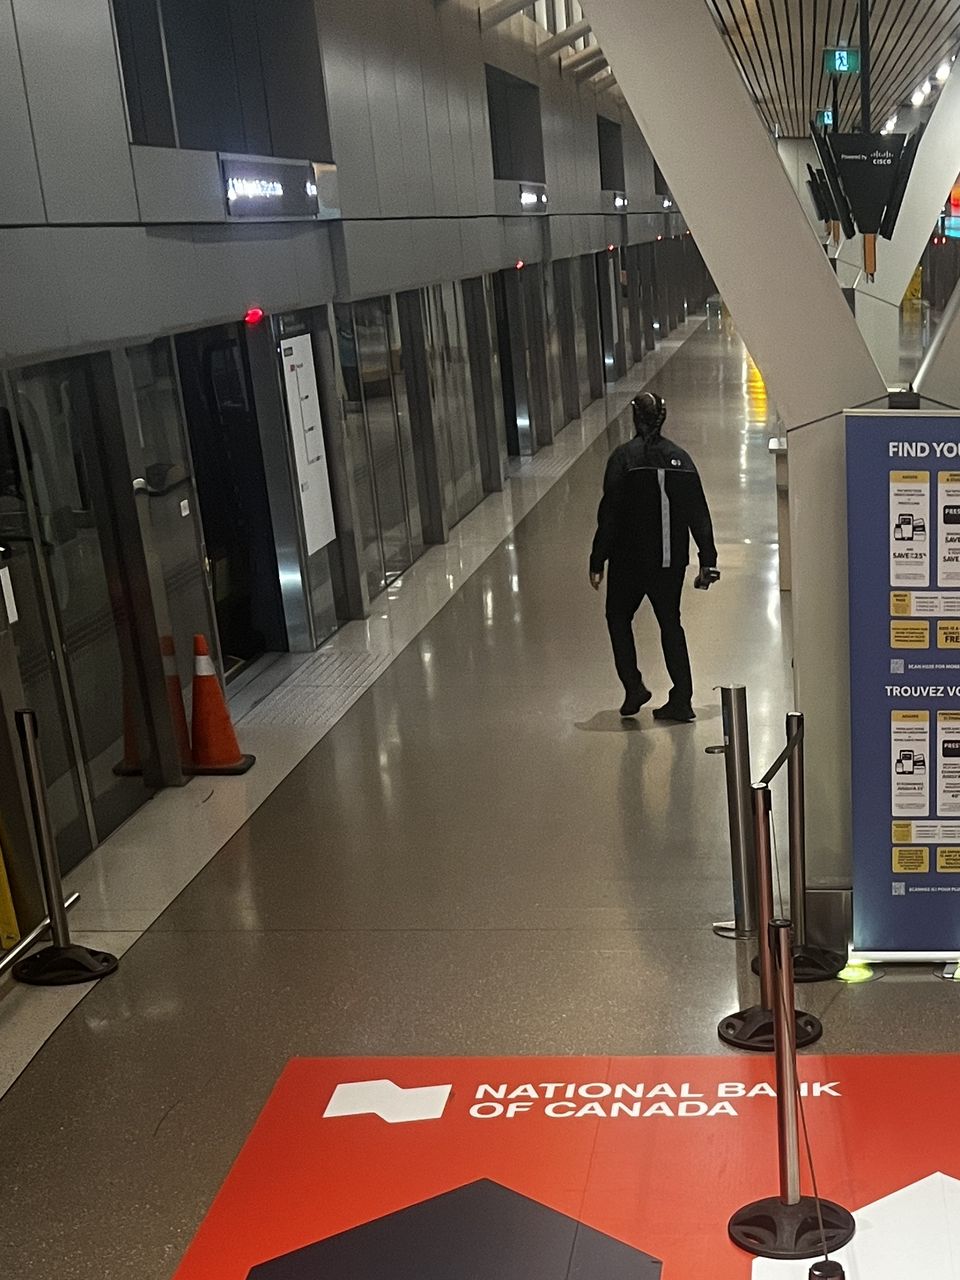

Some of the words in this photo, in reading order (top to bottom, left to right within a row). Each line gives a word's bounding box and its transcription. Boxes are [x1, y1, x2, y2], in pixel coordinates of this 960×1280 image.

[889, 442, 930, 457] FIND
[885, 686, 944, 697] TROUVEZ
[474, 1082, 709, 1100] NATIONAL
[469, 1101, 534, 1118] OF
[544, 1100, 738, 1118] CANADA
